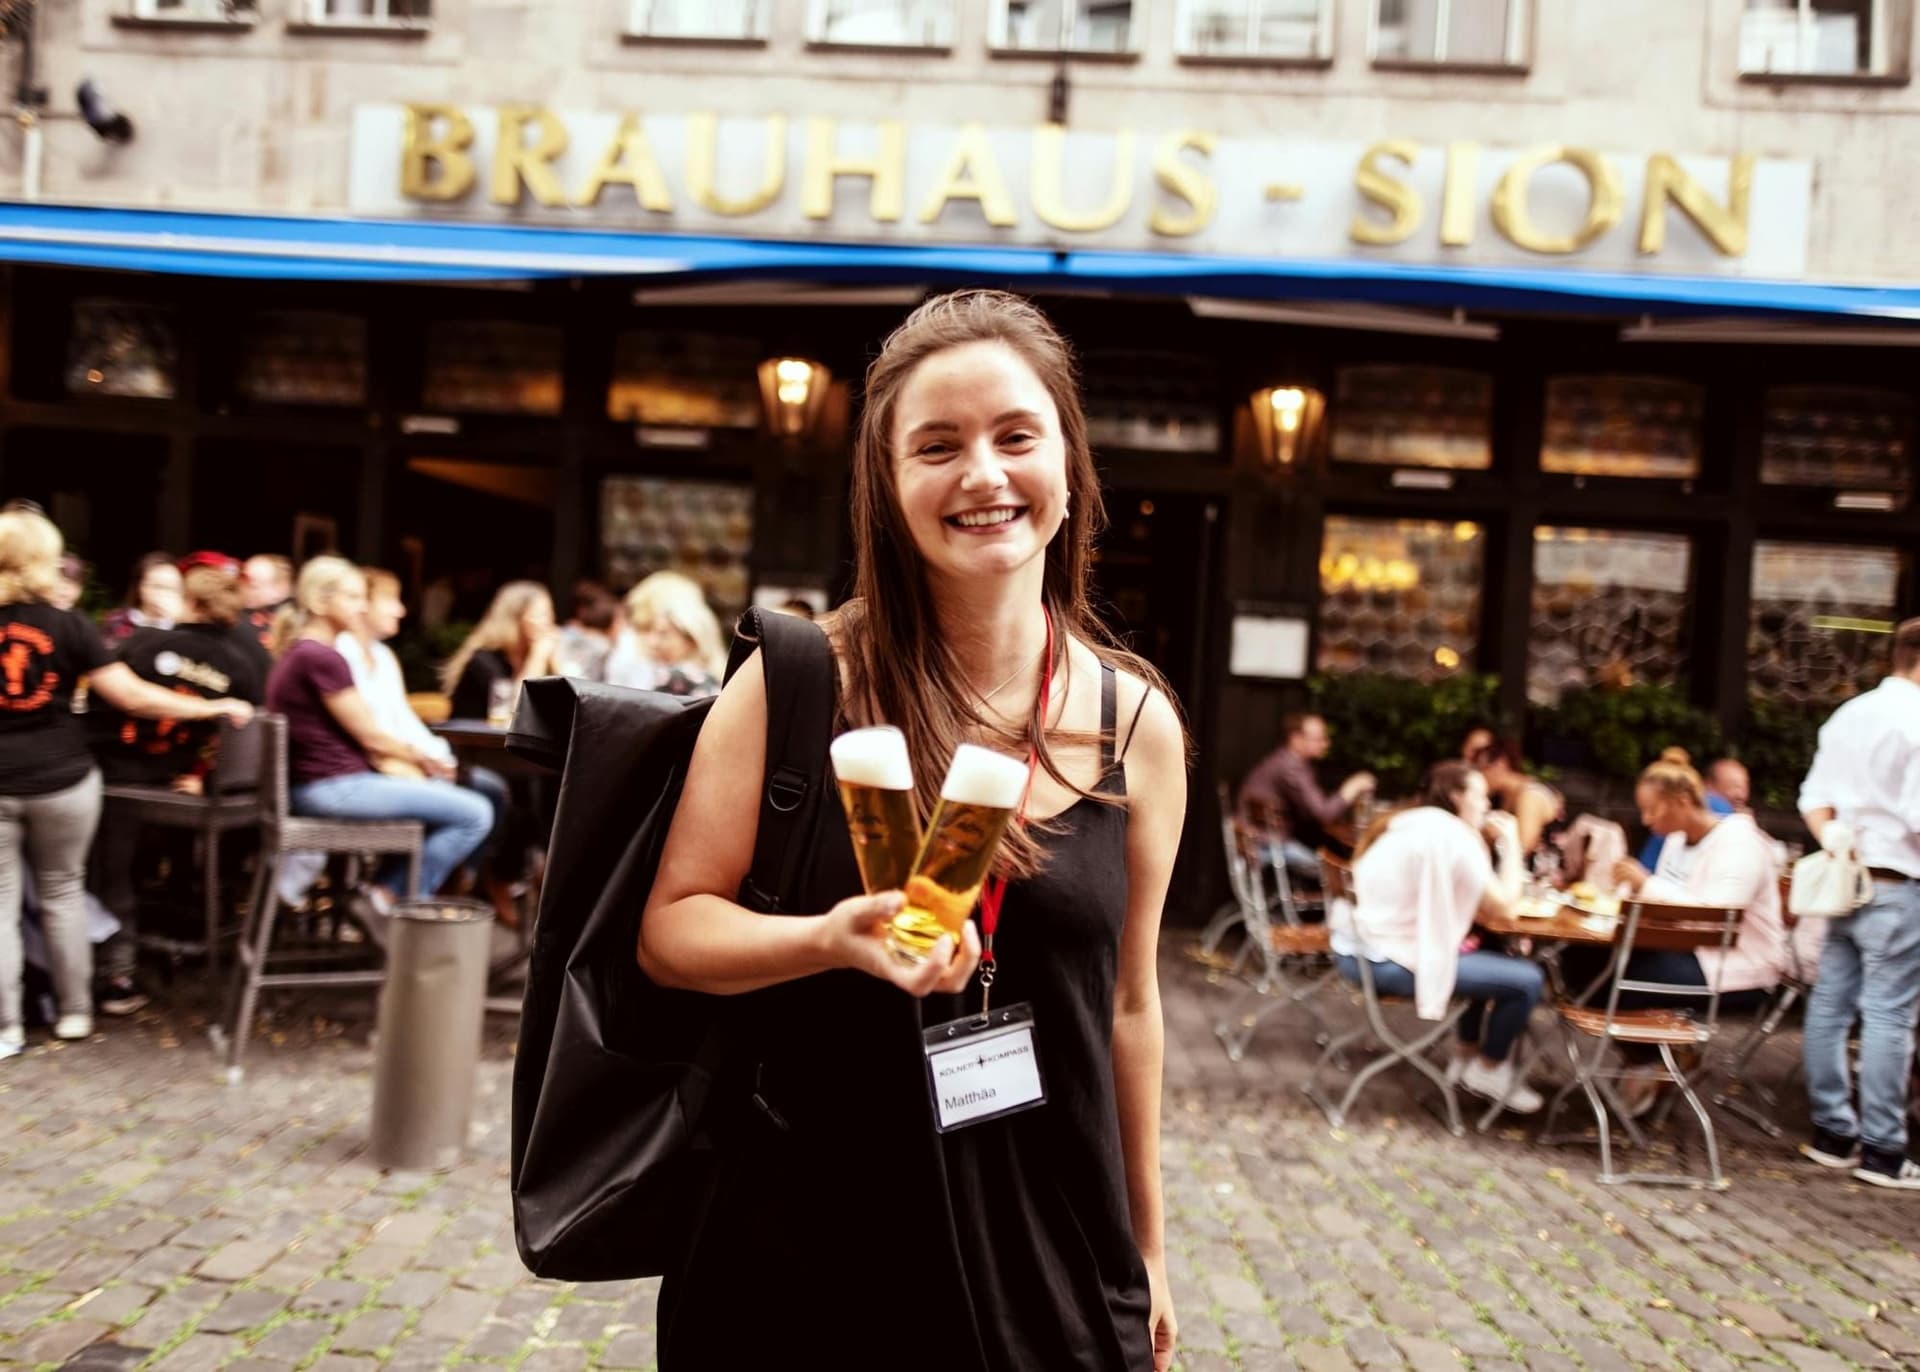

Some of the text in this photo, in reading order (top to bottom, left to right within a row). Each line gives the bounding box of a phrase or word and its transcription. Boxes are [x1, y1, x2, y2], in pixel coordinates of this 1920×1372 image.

[400, 102, 1756, 257] BRAUHAUS - SION
[987, 1045, 1029, 1062] KOMPASS
